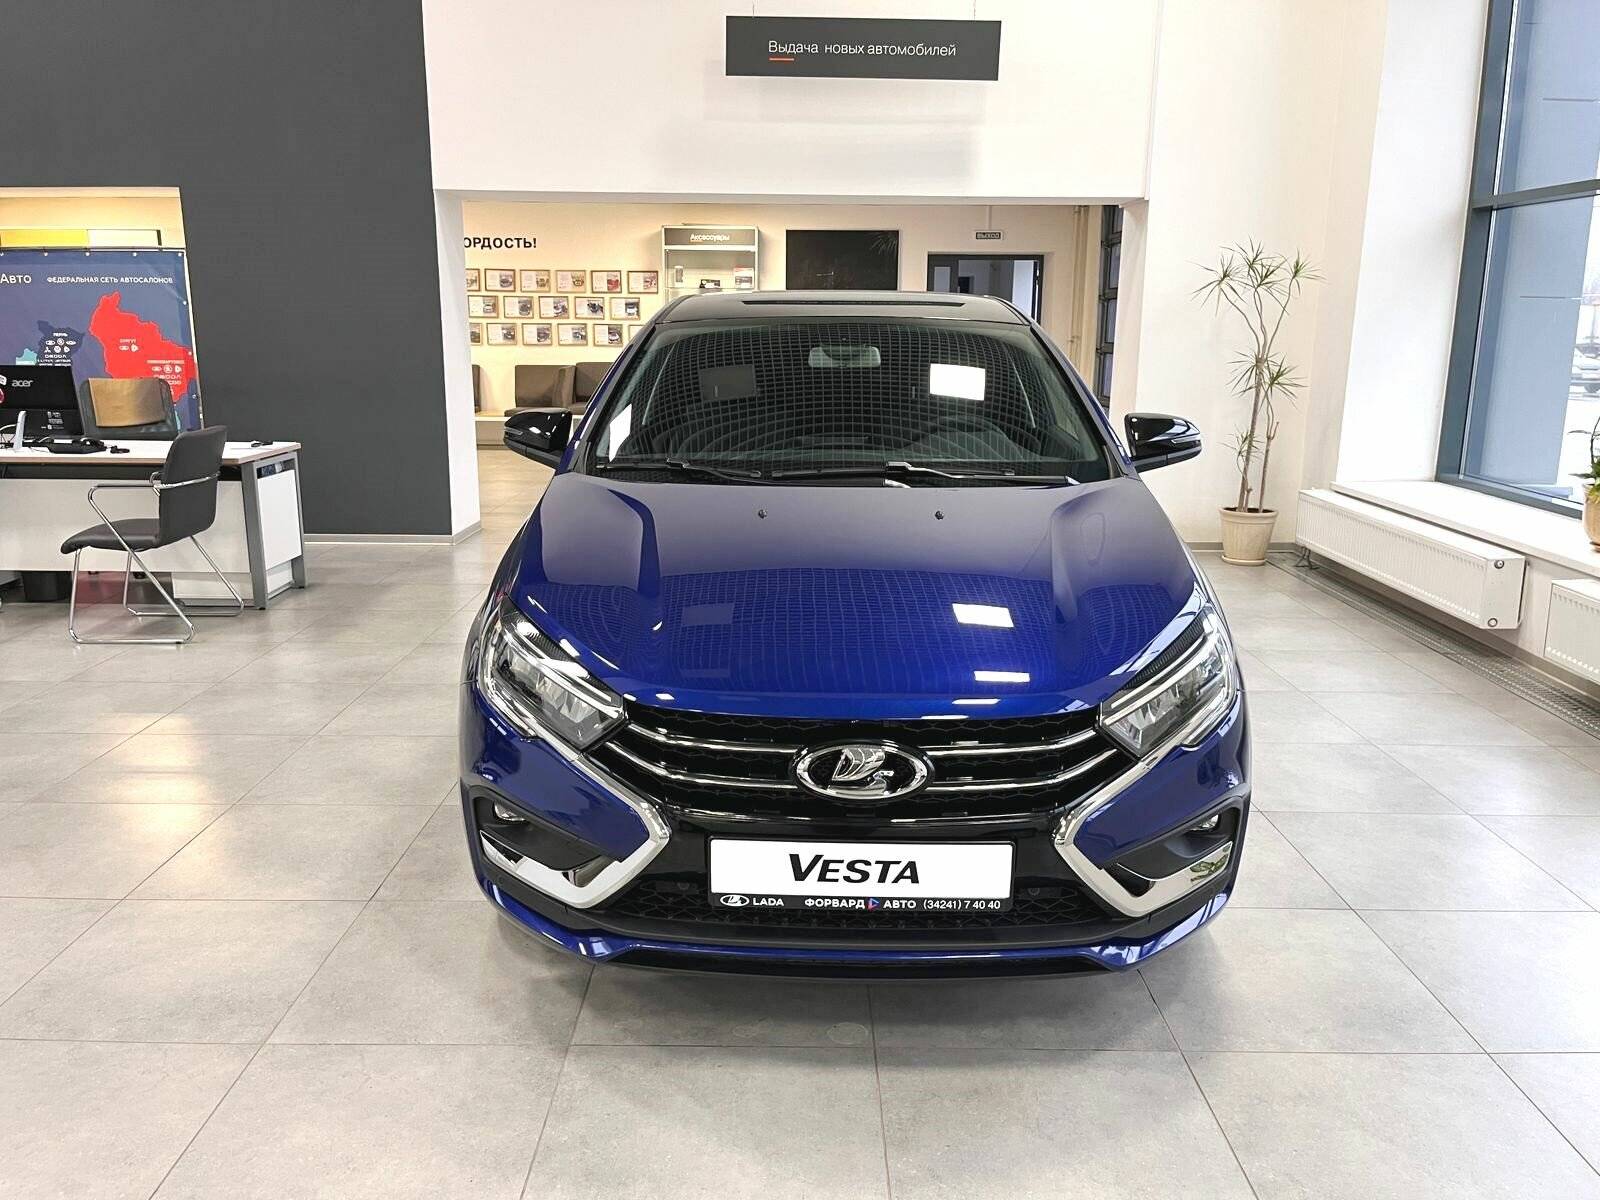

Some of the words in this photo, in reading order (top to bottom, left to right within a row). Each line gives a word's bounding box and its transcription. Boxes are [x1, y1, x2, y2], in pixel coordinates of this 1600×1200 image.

[768, 40, 819, 56] Выдача
[824, 43, 865, 55] новых
[867, 43, 957, 57] автомобилей
[464, 236, 537, 250] ОРДОСТЬ!
[46, 276, 99, 284] ФЕДЕРАЛЬНАЯ
[100, 276, 119, 284] СЕТЬ
[120, 276, 173, 284] АВТОСАЛОНОВ
[11, 379, 34, 388] acer
[788, 853, 920, 884] VESTA
[752, 897, 784, 906] LADA
[804, 898, 865, 910] ФОРВАРД
[883, 900, 916, 909] АВТО
[923, 899, 962, 910] (34241)
[964, 900, 971, 909] 7
[972, 900, 986, 910] 40
[987, 900, 1001, 910] 40
